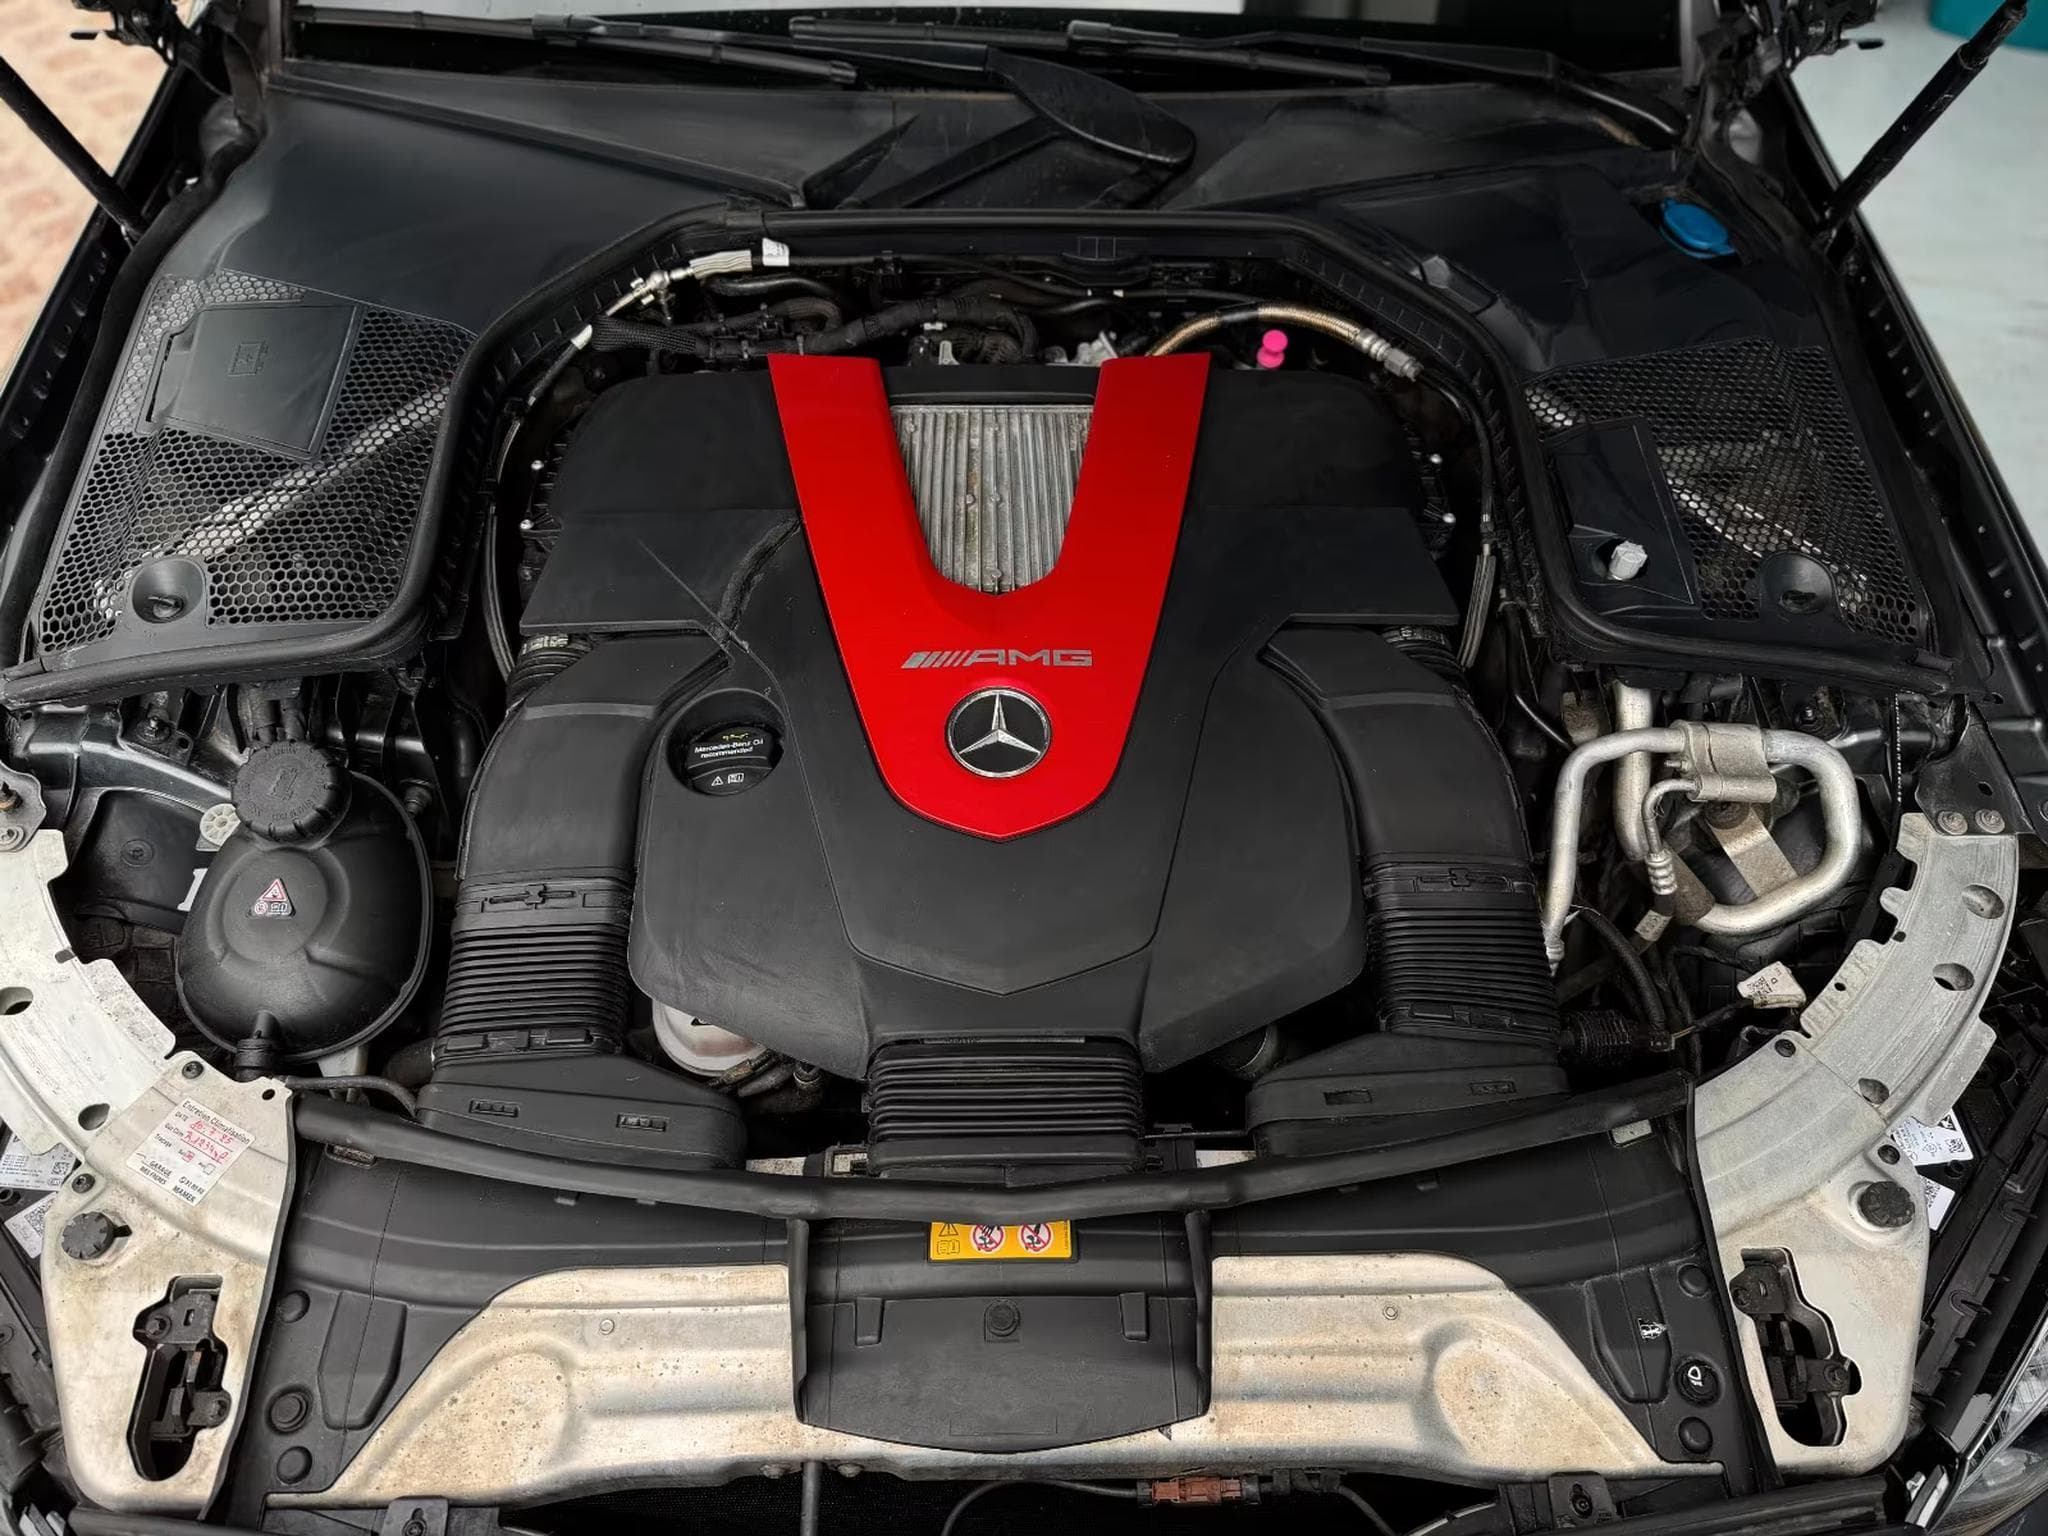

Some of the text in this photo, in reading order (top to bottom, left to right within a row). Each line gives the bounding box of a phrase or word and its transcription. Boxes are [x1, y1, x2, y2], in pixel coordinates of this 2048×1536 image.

[963, 649, 1092, 667] AMG
[694, 741, 751, 753] Mercedes-Benz
[701, 746, 754, 758] recommended
[175, 1112, 188, 1121] DATE
[182, 1101, 250, 1144] Entretien Climatisation
[149, 1161, 172, 1176] GARAGE
[173, 1186, 196, 1202] MAMER
